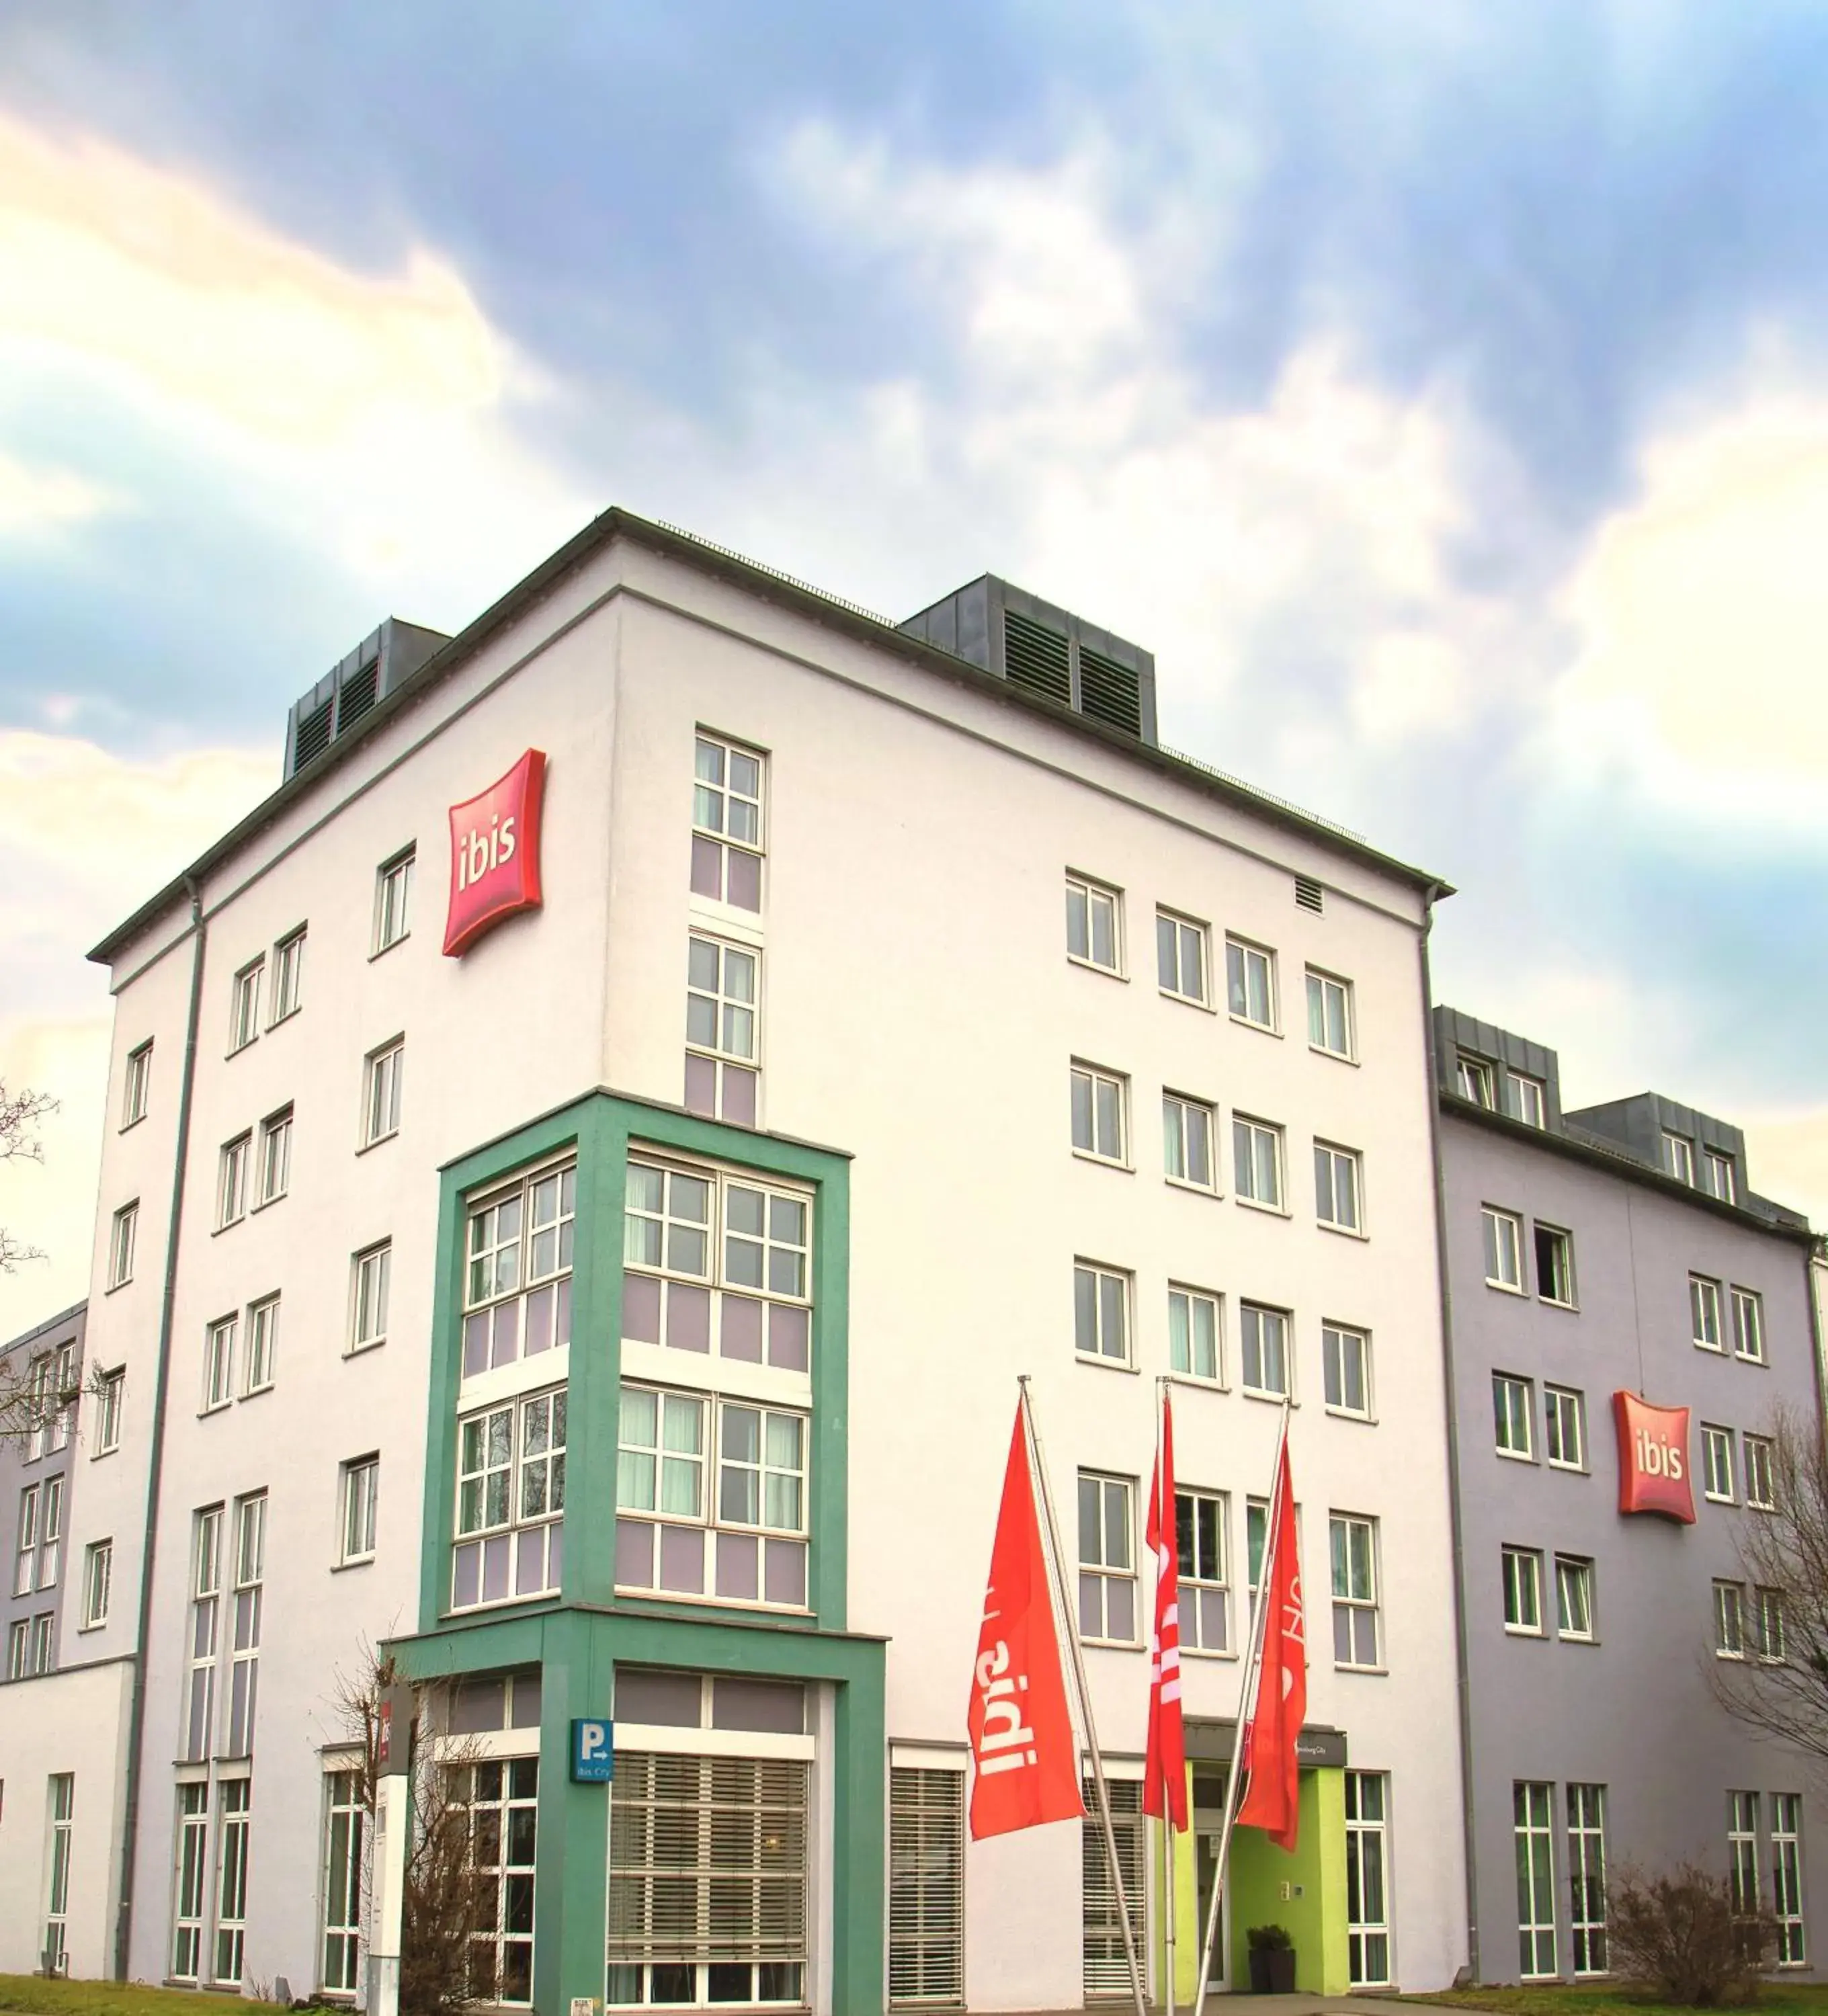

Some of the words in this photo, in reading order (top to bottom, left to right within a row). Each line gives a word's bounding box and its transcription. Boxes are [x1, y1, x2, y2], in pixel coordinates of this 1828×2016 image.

[459, 814, 515, 892] ibis
[1636, 1429, 1683, 1481] ibis
[581, 1723, 605, 1760] P
